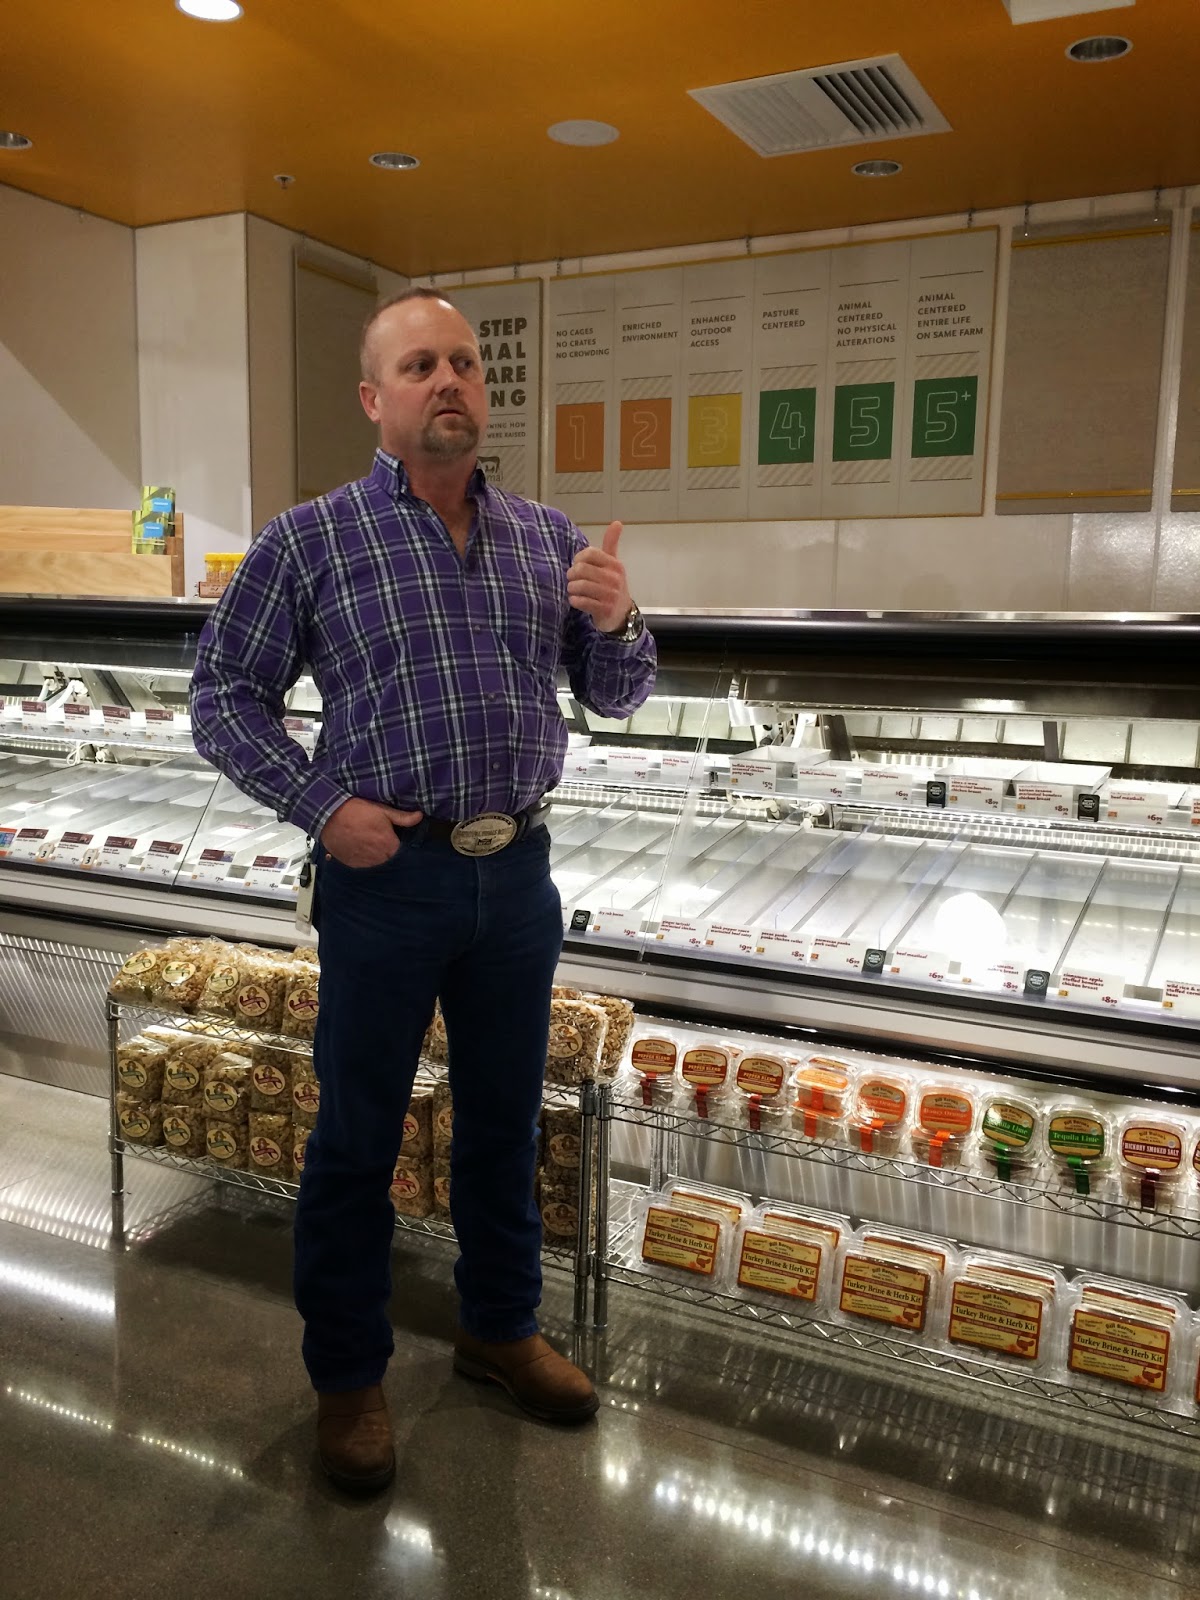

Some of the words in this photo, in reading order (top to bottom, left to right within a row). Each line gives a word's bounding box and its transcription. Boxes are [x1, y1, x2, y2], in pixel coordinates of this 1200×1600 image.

[918, 293, 955, 303] ANIMAL
[837, 301, 872, 311] ANIMAL
[918, 304, 966, 315] CENTERED
[762, 308, 799, 318] PASTURE
[837, 312, 883, 323] CENTERED
[691, 314, 736, 325] ENHANCED
[761, 320, 805, 330] CENTERED
[917, 318, 949, 328] ENTIRE
[952, 316, 971, 325] LIFE
[479, 317, 528, 338] STEP
[570, 327, 594, 336] CAGES
[622, 321, 662, 331] ENRICHED
[690, 326, 732, 336] OUTDOOR
[837, 327, 851, 335] NO
[854, 323, 897, 333] PHYSICAL
[622, 331, 678, 342] ENVIRONMENT
[916, 332, 930, 340] ON
[933, 329, 957, 339] SAME
[959, 327, 984, 337] FARM
[569, 339, 596, 347] CRATES
[690, 339, 719, 347] ACCESS
[836, 336, 896, 347] ALTERATIONS
[479, 341, 526, 361] MAL
[569, 348, 610, 358] CROWDING
[485, 365, 526, 385] ARE
[490, 388, 527, 407] NG
[769, 402, 806, 450] 4
[849, 396, 880, 448] 5
[631, 411, 658, 458] 2
[699, 406, 729, 455] 3
[569, 415, 586, 460] 1
[487, 471, 504, 482] mal
[761, 1074, 776, 1082] BLEND
[1011, 1124, 1028, 1135] Lime
[1053, 1131, 1080, 1141] Tequila
[1081, 1134, 1100, 1143] Lime
[1124, 1142, 1146, 1152] HICKORY
[1146, 1145, 1167, 1155] SMOKED
[1167, 1148, 1179, 1156] SALT
[648, 1229, 666, 1240] Turkey
[667, 1234, 681, 1243] Brine
[689, 1239, 703, 1248] Herb
[703, 1242, 713, 1251] Kit
[745, 1253, 765, 1264] Turkey
[765, 1257, 782, 1267] Brine
[789, 1263, 804, 1273] Herb
[805, 1267, 815, 1275] Kit
[846, 1280, 867, 1291] Turkey
[868, 1285, 885, 1296] Brine
[893, 1291, 910, 1300] Herb
[911, 1295, 921, 1303] Kit
[955, 1306, 978, 1319] Turkey
[979, 1312, 997, 1322] Brine
[1006, 1318, 1023, 1329] Herb
[1024, 1322, 1035, 1331] Kit
[1076, 1335, 1100, 1349] Turkey
[1102, 1341, 1121, 1352] Brine
[1131, 1348, 1149, 1359] Herb
[1151, 1353, 1162, 1363] Kit
